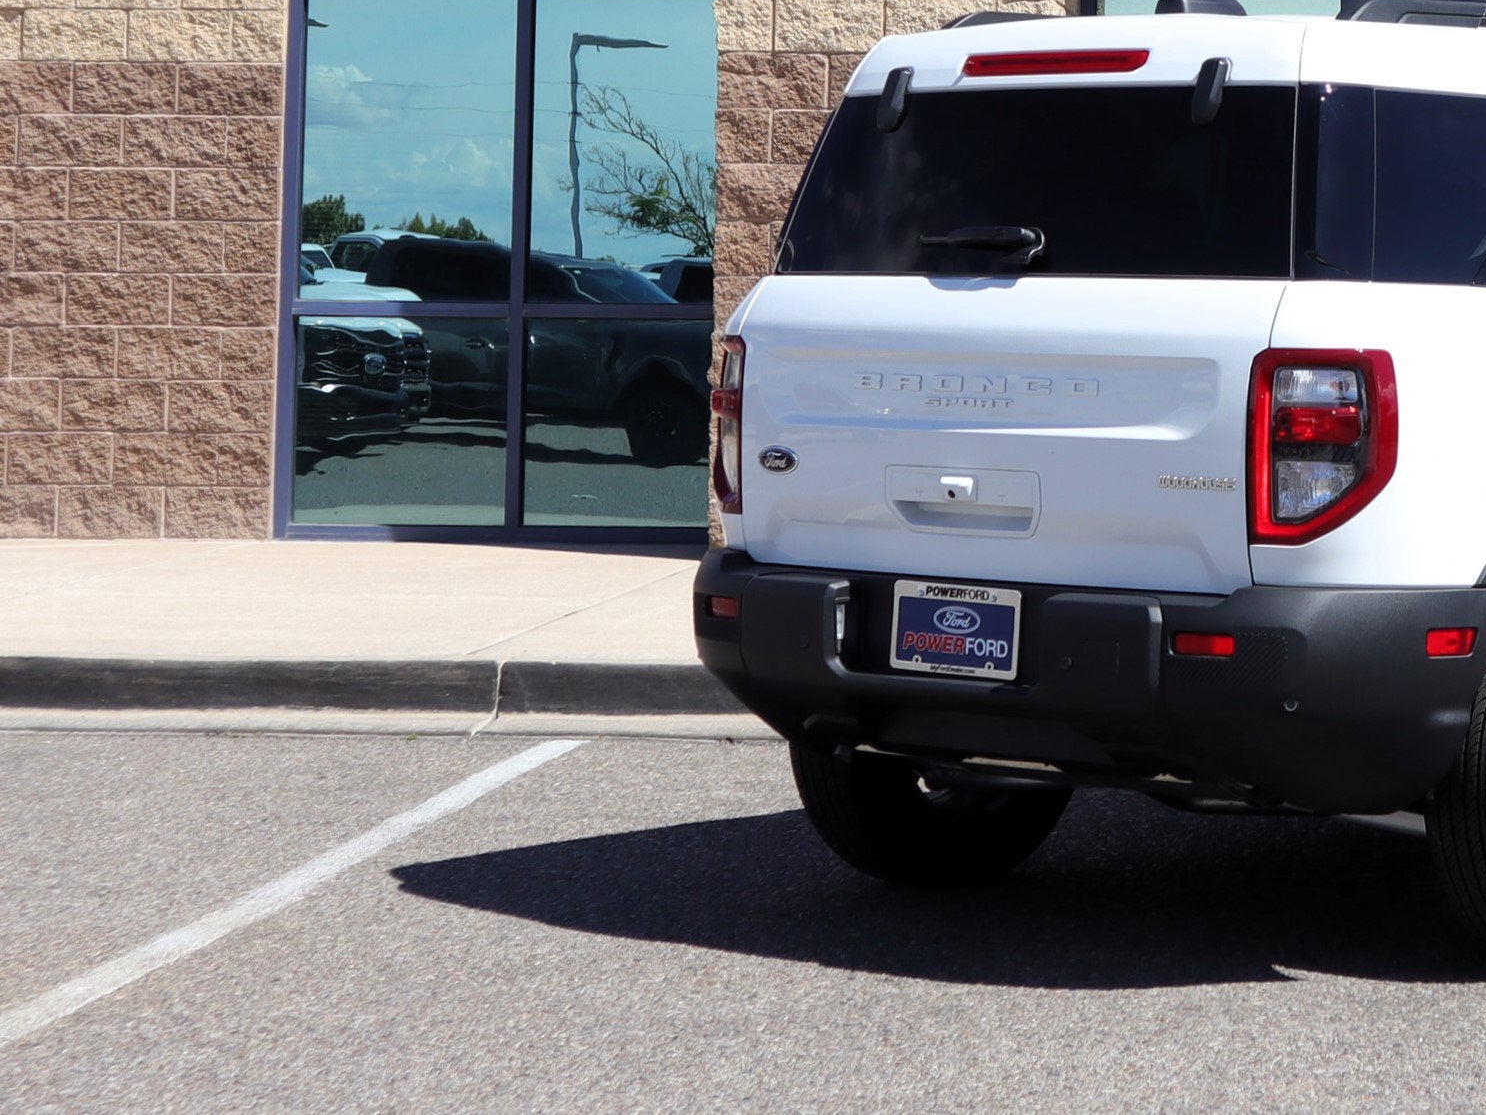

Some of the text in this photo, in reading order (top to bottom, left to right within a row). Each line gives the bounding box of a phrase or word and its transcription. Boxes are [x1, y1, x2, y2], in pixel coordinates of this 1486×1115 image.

[854, 372, 1100, 398] BRONCO
[924, 396, 1014, 409] SPORT
[764, 451, 787, 467] Ford
[925, 585, 990, 601] POWERFORD
[942, 611, 971, 628] Ford
[902, 631, 1009, 658] POWERFORD
